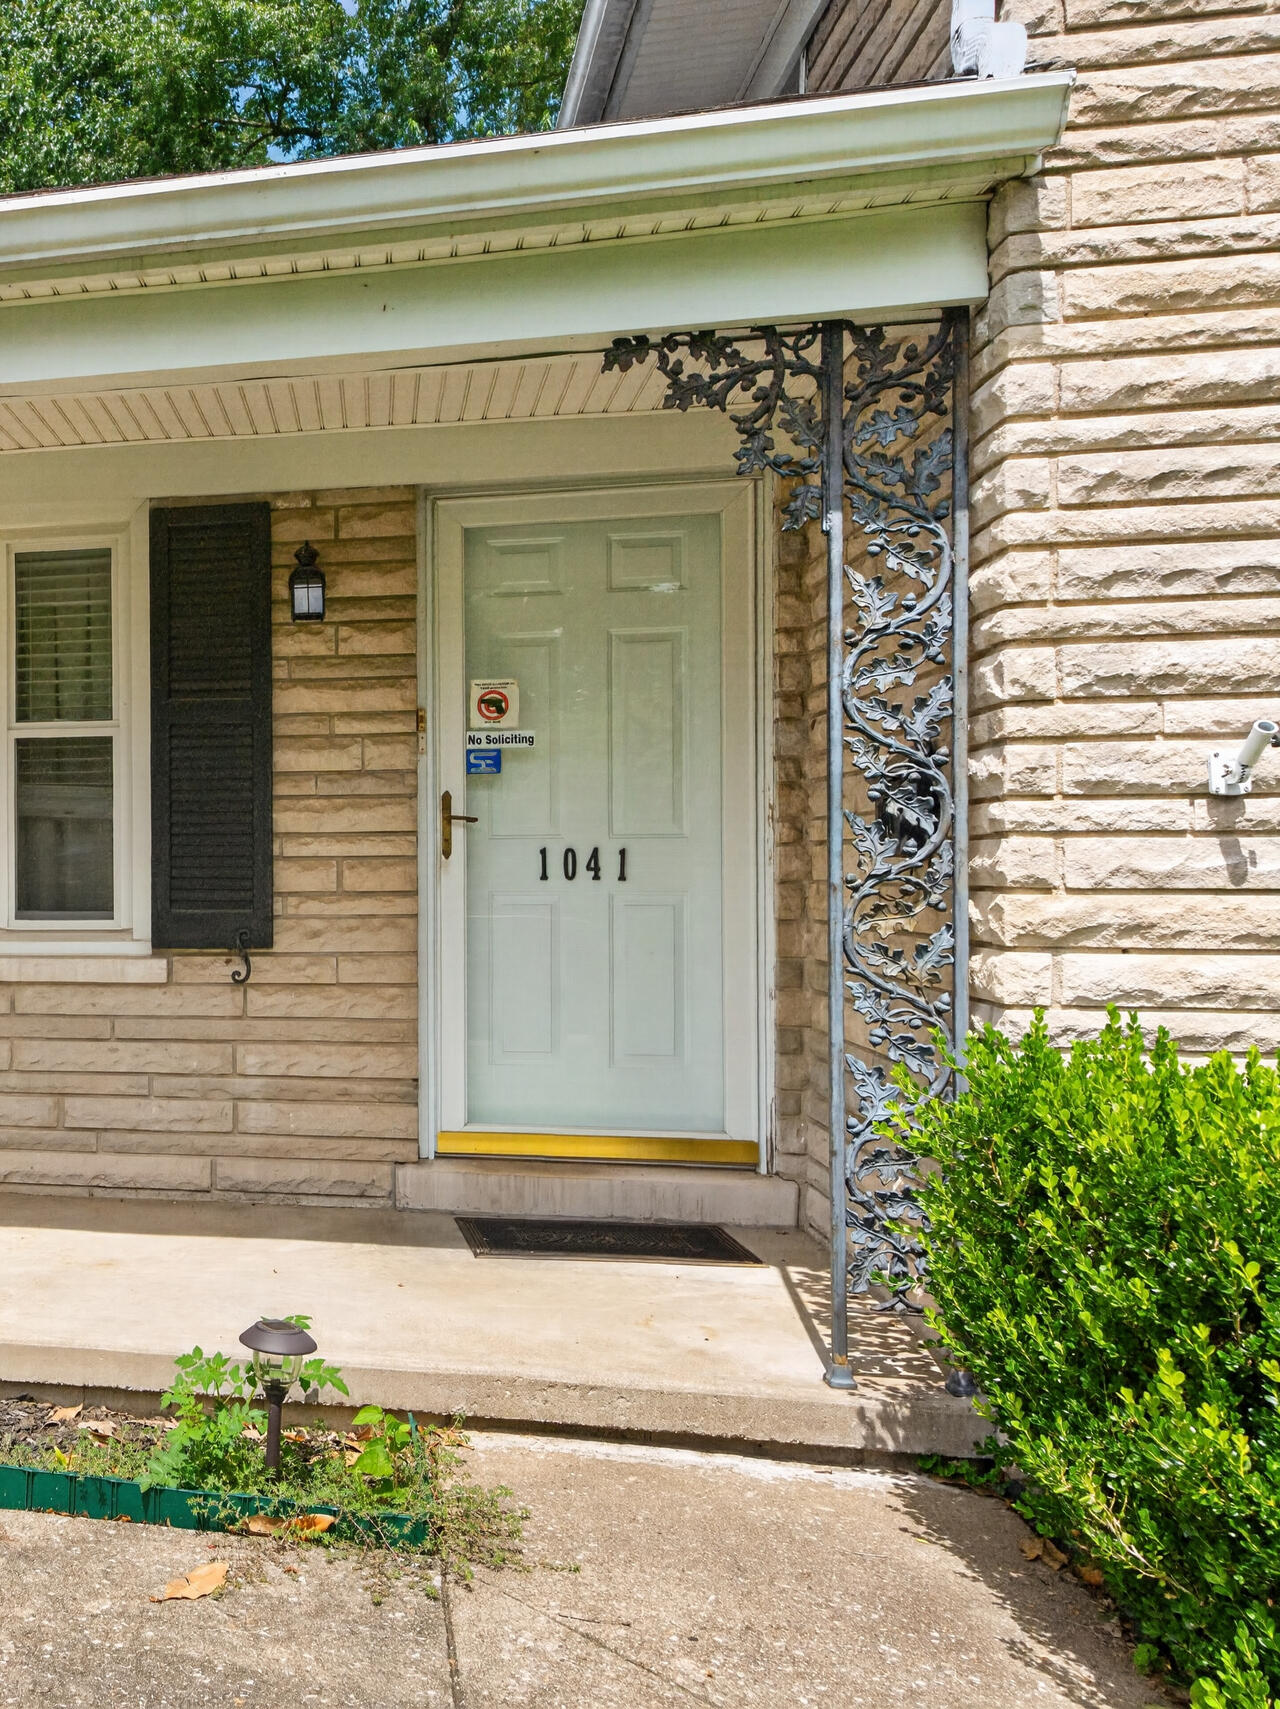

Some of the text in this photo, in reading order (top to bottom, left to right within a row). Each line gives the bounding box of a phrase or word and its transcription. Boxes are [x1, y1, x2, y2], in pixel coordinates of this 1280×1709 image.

[468, 734, 534, 746] No Soliciting
[539, 847, 626, 881] 1041
